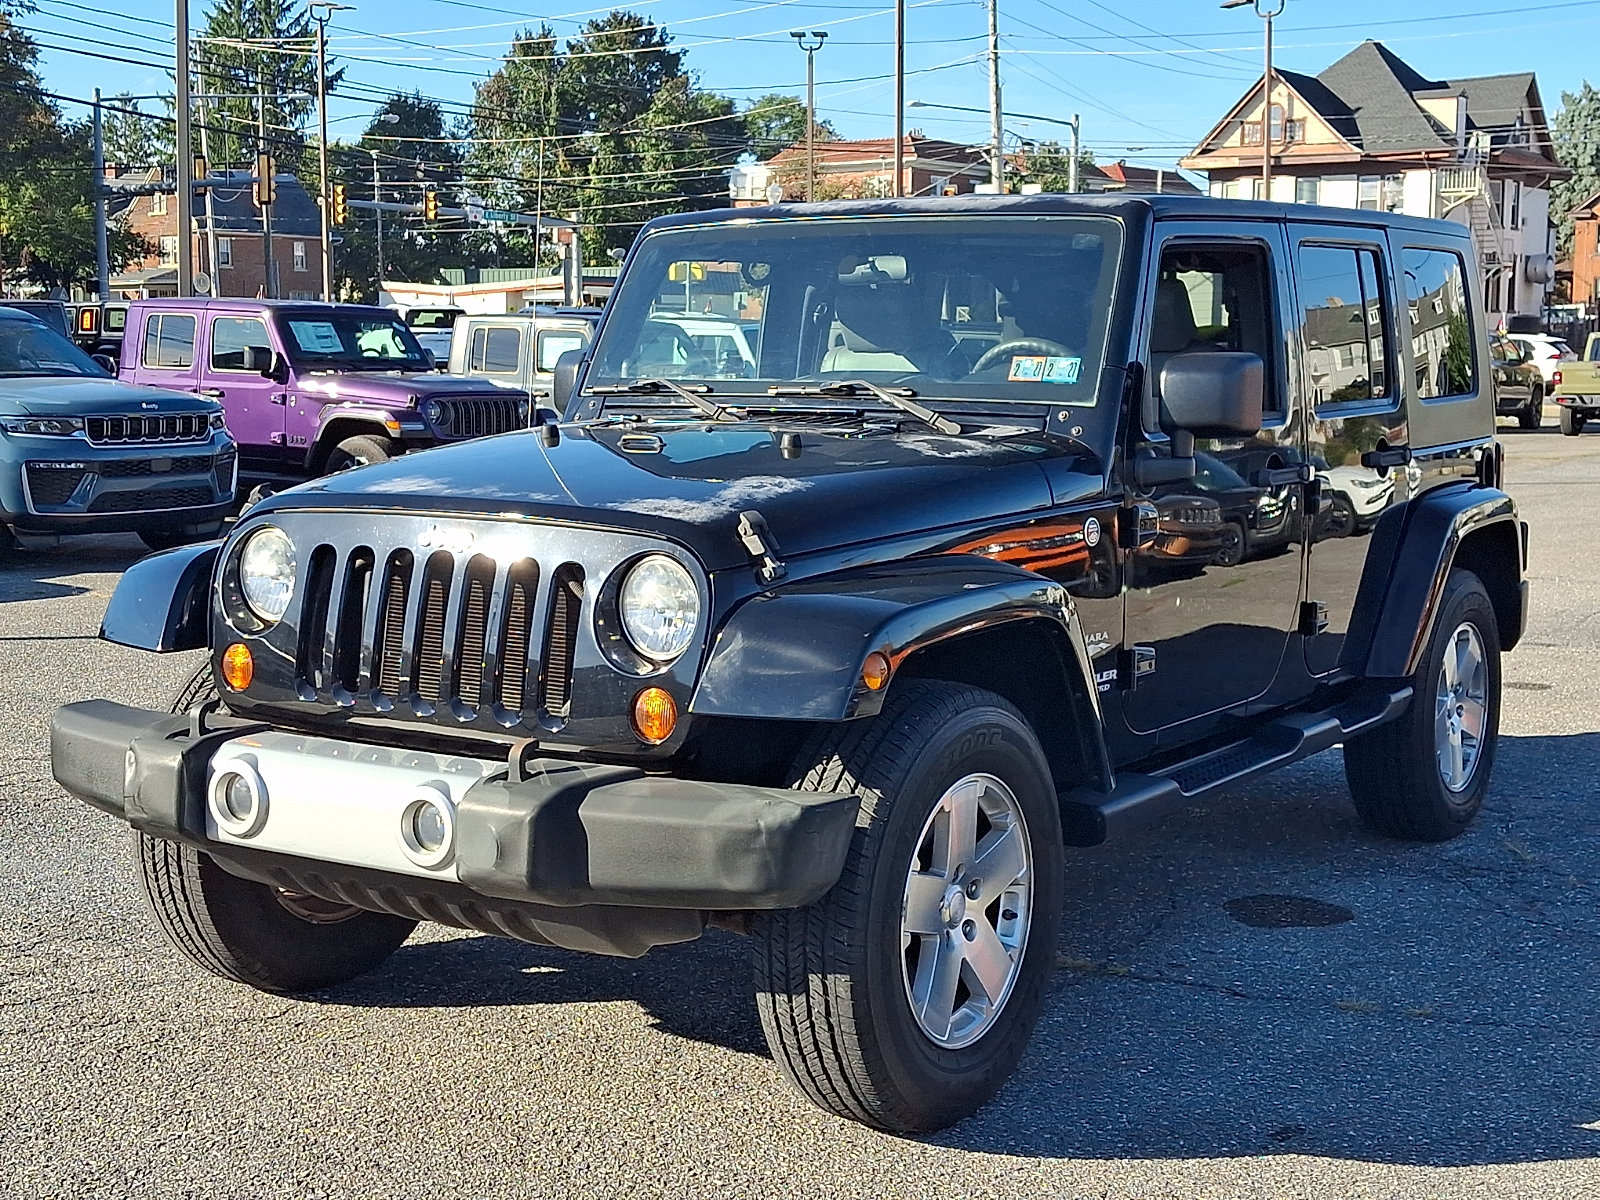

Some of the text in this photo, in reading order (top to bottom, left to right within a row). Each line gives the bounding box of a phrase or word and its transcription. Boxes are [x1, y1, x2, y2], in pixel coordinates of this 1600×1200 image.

[490, 211, 509, 221] Liberty
[1013, 361, 1043, 377] 2 27
[1046, 361, 1078, 378] 2 27
[1095, 669, 1118, 683] LER
